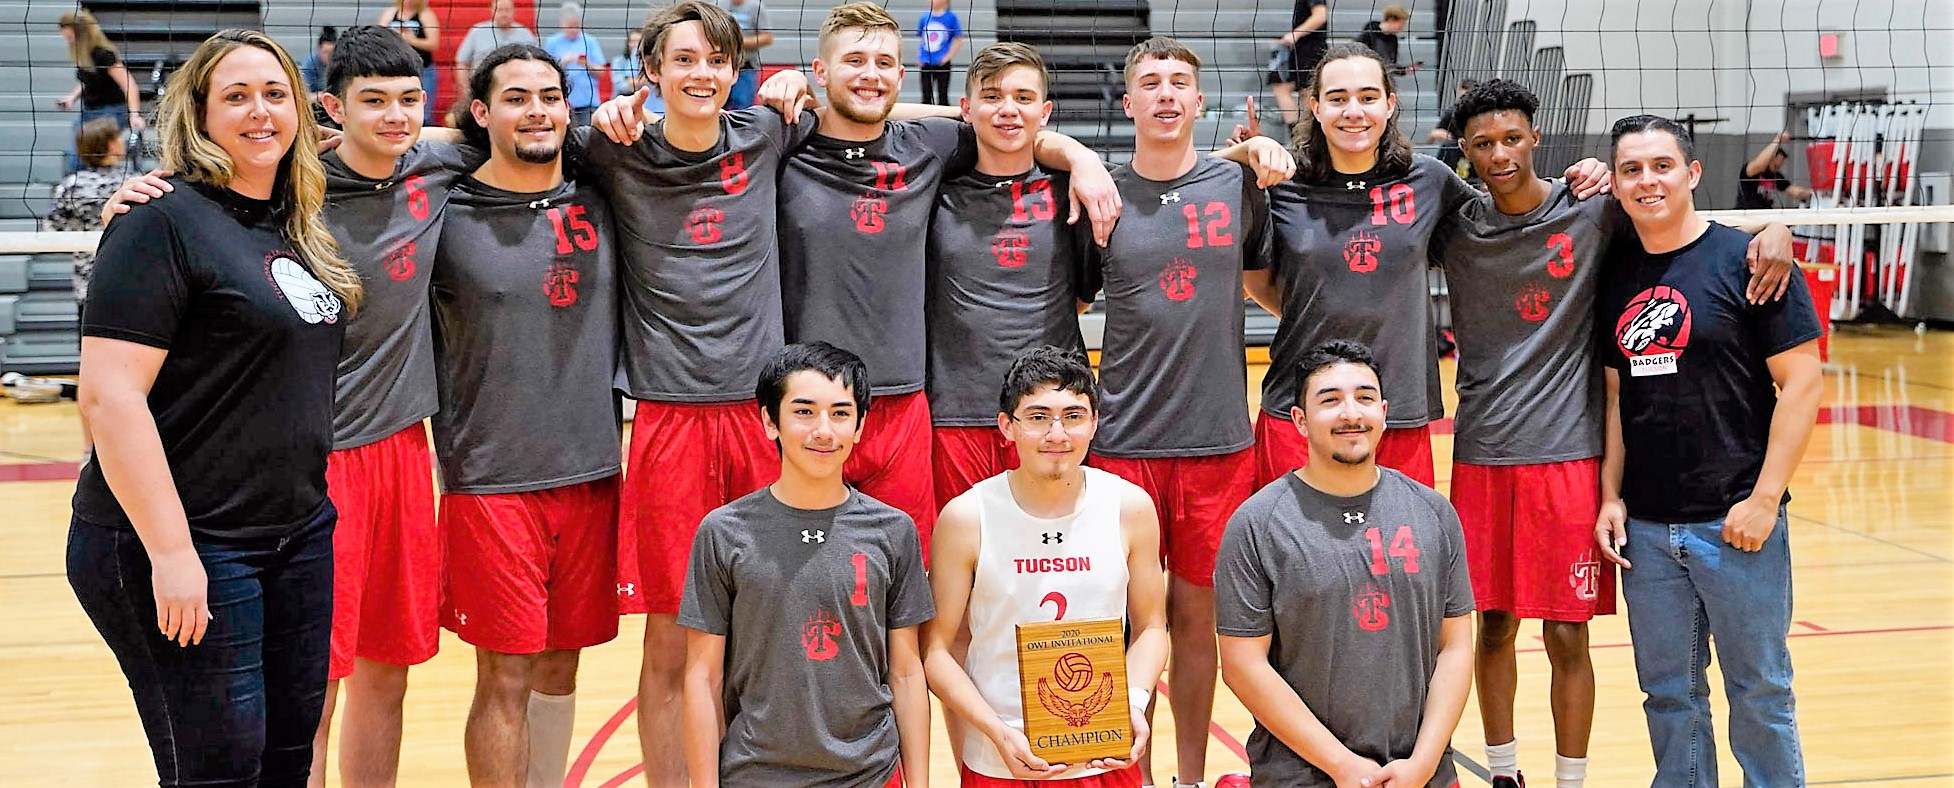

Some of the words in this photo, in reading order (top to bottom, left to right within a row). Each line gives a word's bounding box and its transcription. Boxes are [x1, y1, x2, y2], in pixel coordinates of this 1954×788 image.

[720, 152, 748, 194] 8
[405, 175, 429, 220] 6
[1010, 179, 1056, 222] 13
[1369, 183, 1416, 225] 10
[546, 205, 598, 254] 15
[1183, 201, 1233, 249] 12
[1546, 233, 1574, 277] 3
[1632, 355, 1675, 367] BADGERS
[1013, 556, 1091, 574] TUCSON
[1365, 526, 1420, 575] 14
[851, 553, 868, 606] 1
[1574, 561, 1601, 598] T
[1027, 642, 1048, 651] OWL
[1051, 635, 1114, 648] INVITATIONAL
[1061, 629, 1081, 638] 2020
[1037, 729, 1123, 749] CHAMPION
